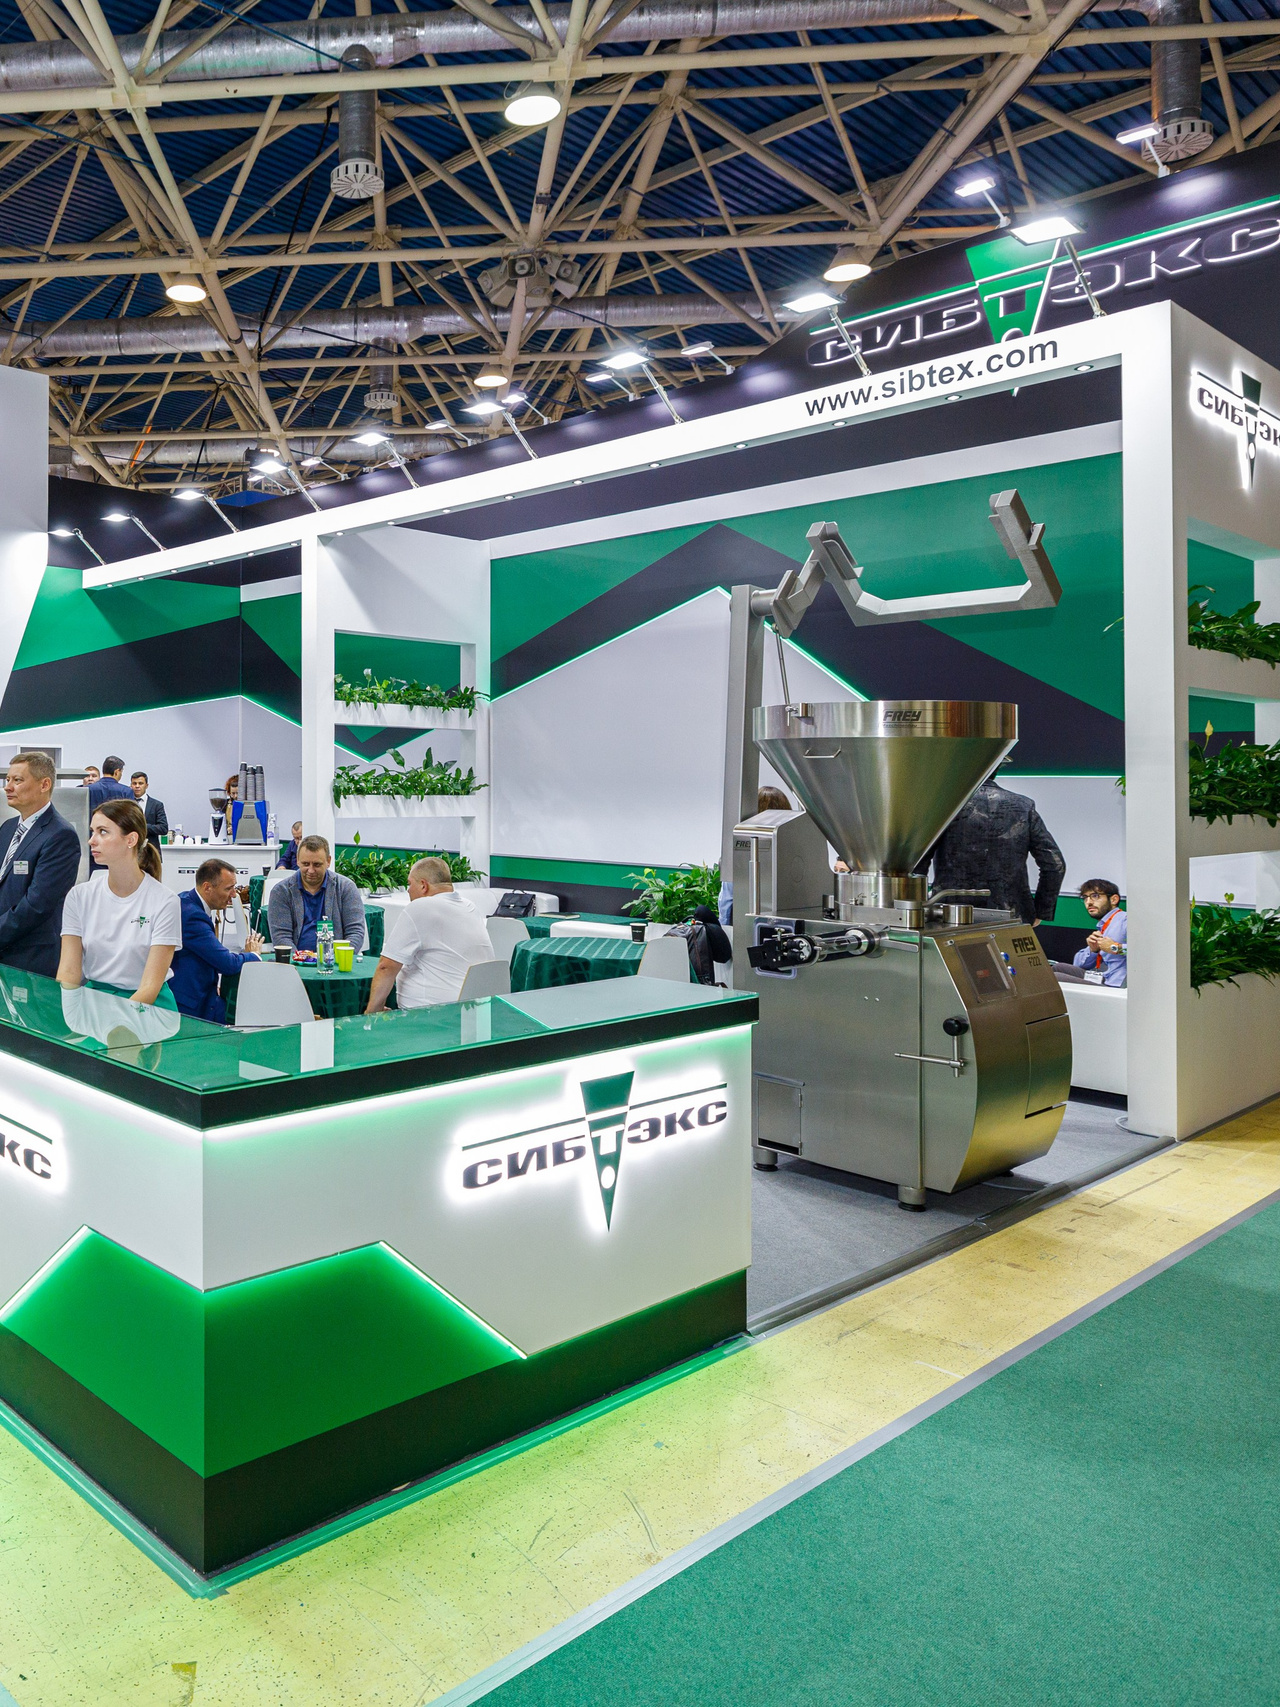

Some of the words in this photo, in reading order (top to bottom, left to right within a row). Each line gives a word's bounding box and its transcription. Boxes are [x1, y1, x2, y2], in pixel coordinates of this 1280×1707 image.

[805, 340, 1059, 417] www.sibtex.com
[1197, 387, 1280, 446] СИБТЭК
[883, 710, 922, 721] FREY
[735, 840, 751, 848] FRE
[1011, 936, 1037, 954] FREY
[1028, 956, 1043, 967] F222
[462, 1100, 727, 1189] СИБТЭКС
